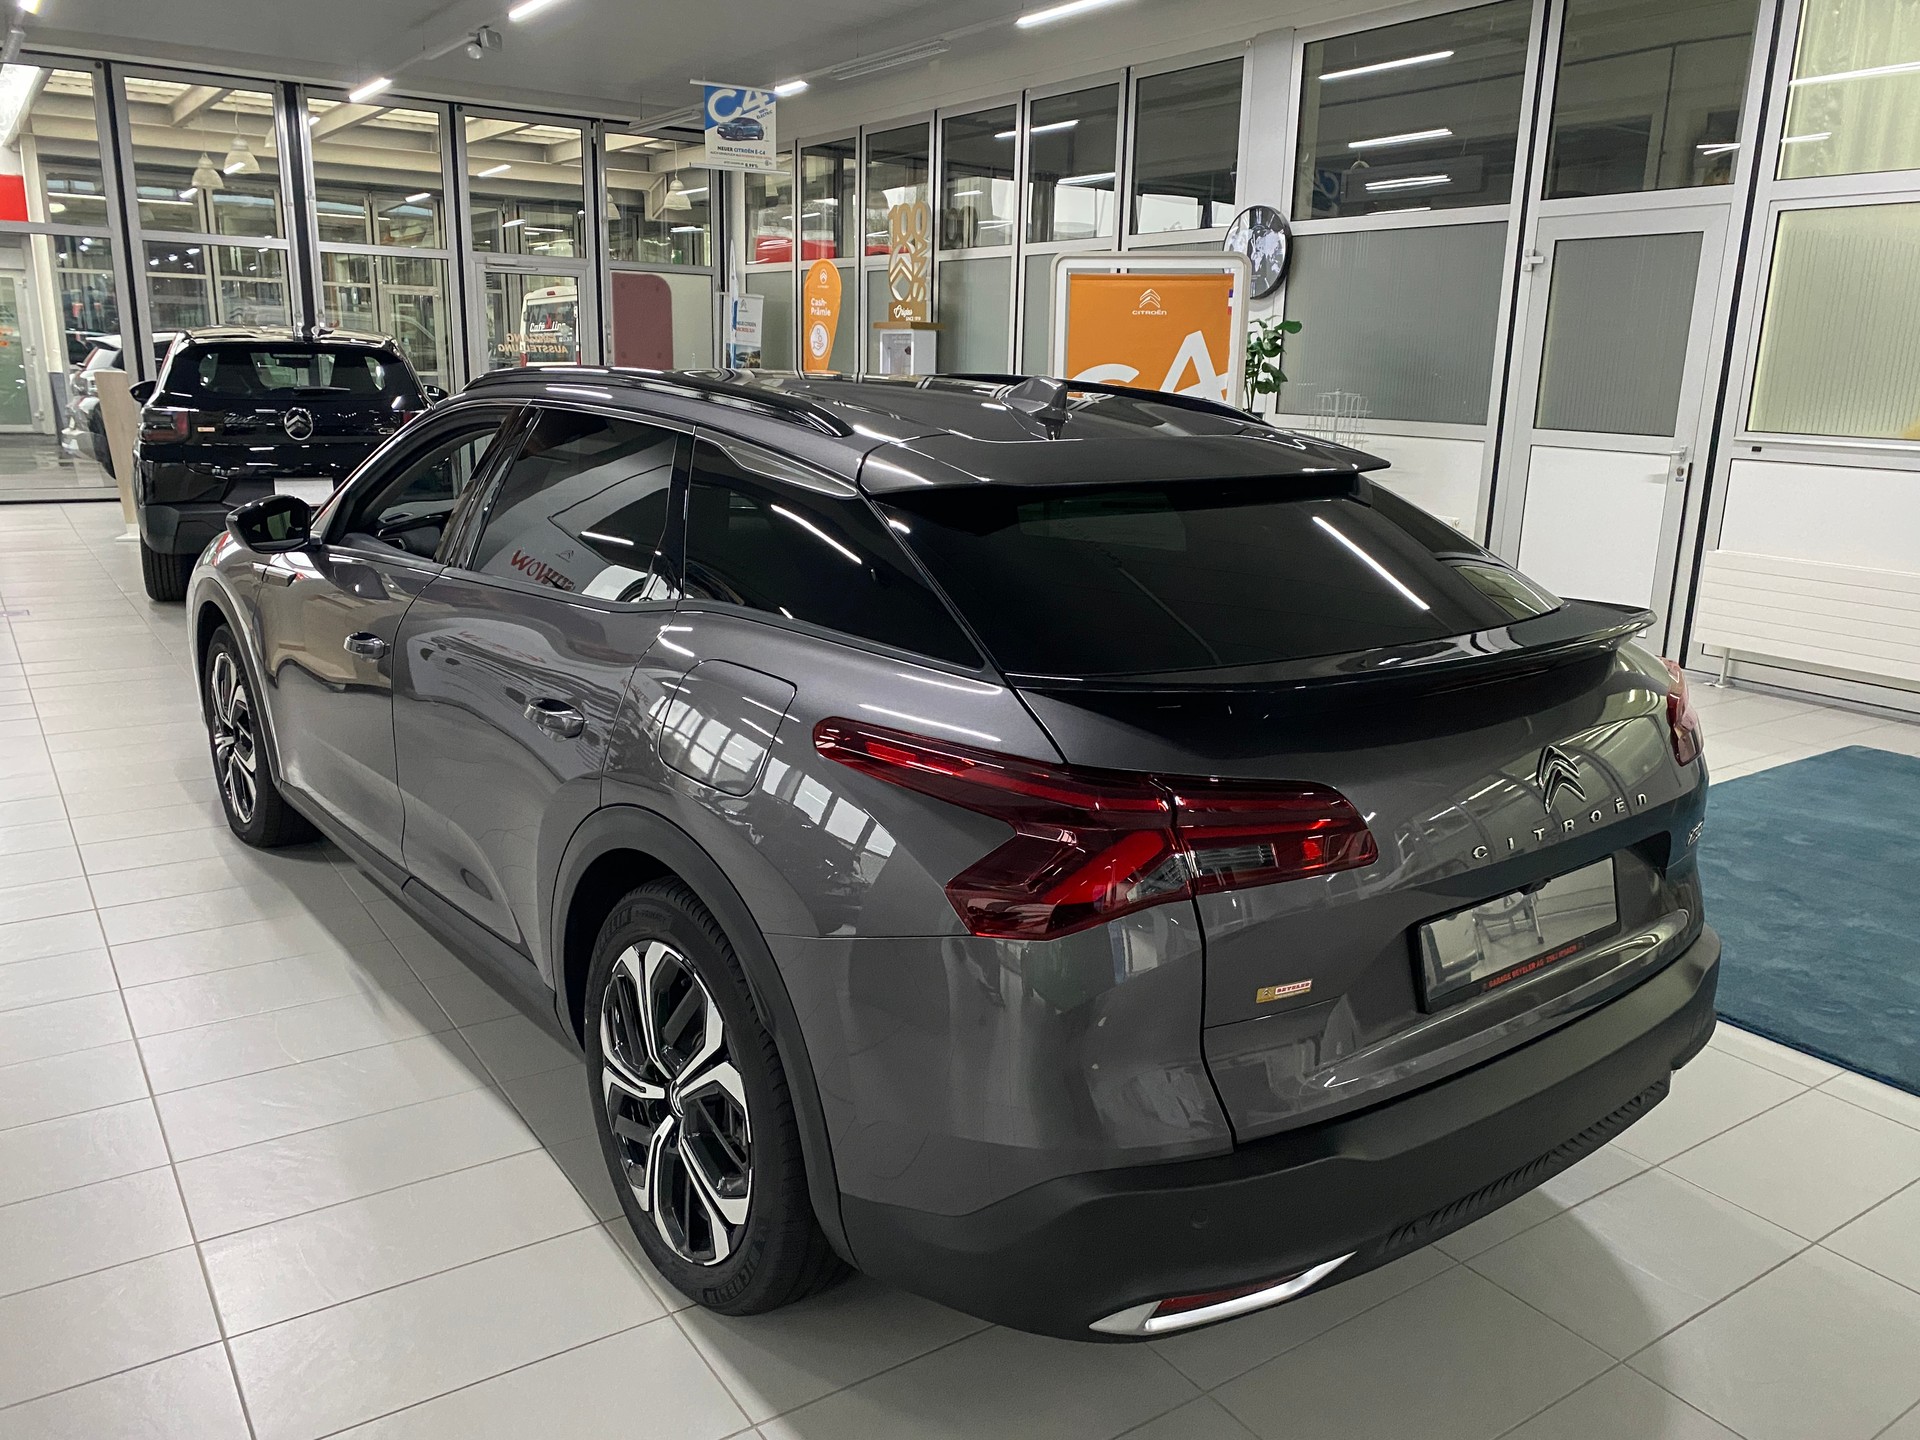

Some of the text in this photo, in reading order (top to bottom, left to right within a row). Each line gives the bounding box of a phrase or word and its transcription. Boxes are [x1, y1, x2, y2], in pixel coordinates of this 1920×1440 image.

[708, 88, 770, 123] C4
[811, 298, 828, 307] Cash-
[810, 307, 832, 317] Prämie
